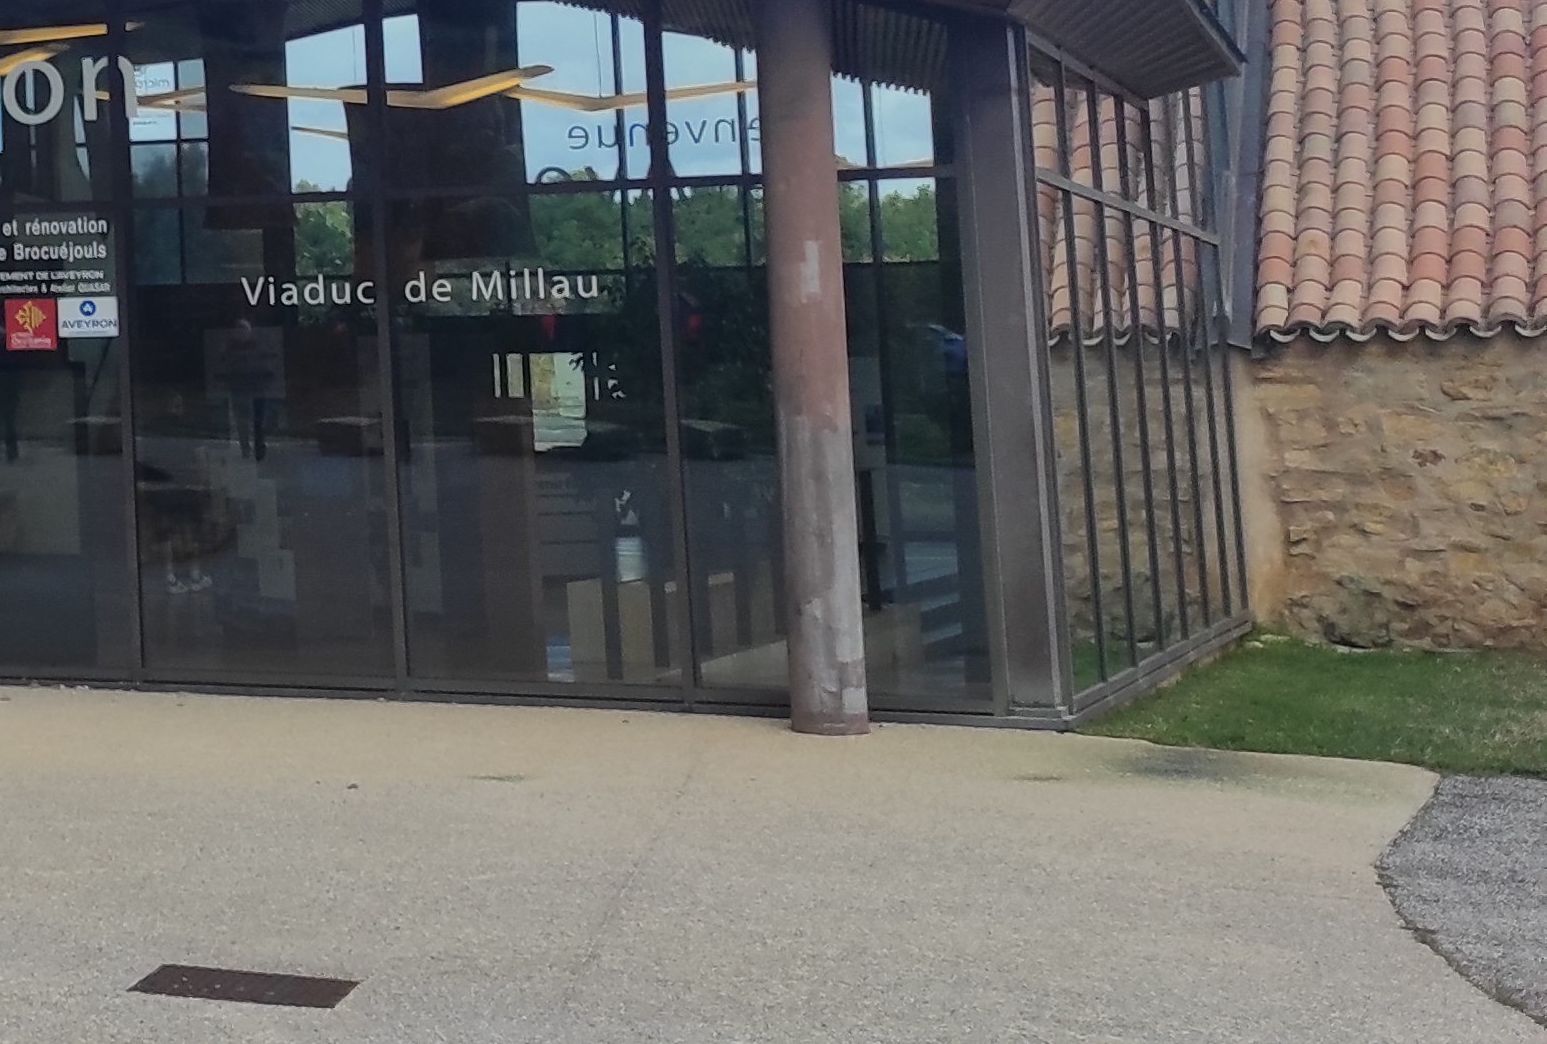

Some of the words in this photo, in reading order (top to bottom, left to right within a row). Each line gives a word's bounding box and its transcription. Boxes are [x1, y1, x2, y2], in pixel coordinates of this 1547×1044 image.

[2, 220, 19, 237] et
[25, 216, 108, 236] rénovation
[13, 241, 108, 263] Brocuéjouls
[240, 273, 376, 306] Viaduc
[404, 270, 453, 303] de
[470, 267, 599, 301] Millau
[61, 319, 117, 329] AVEYRON
